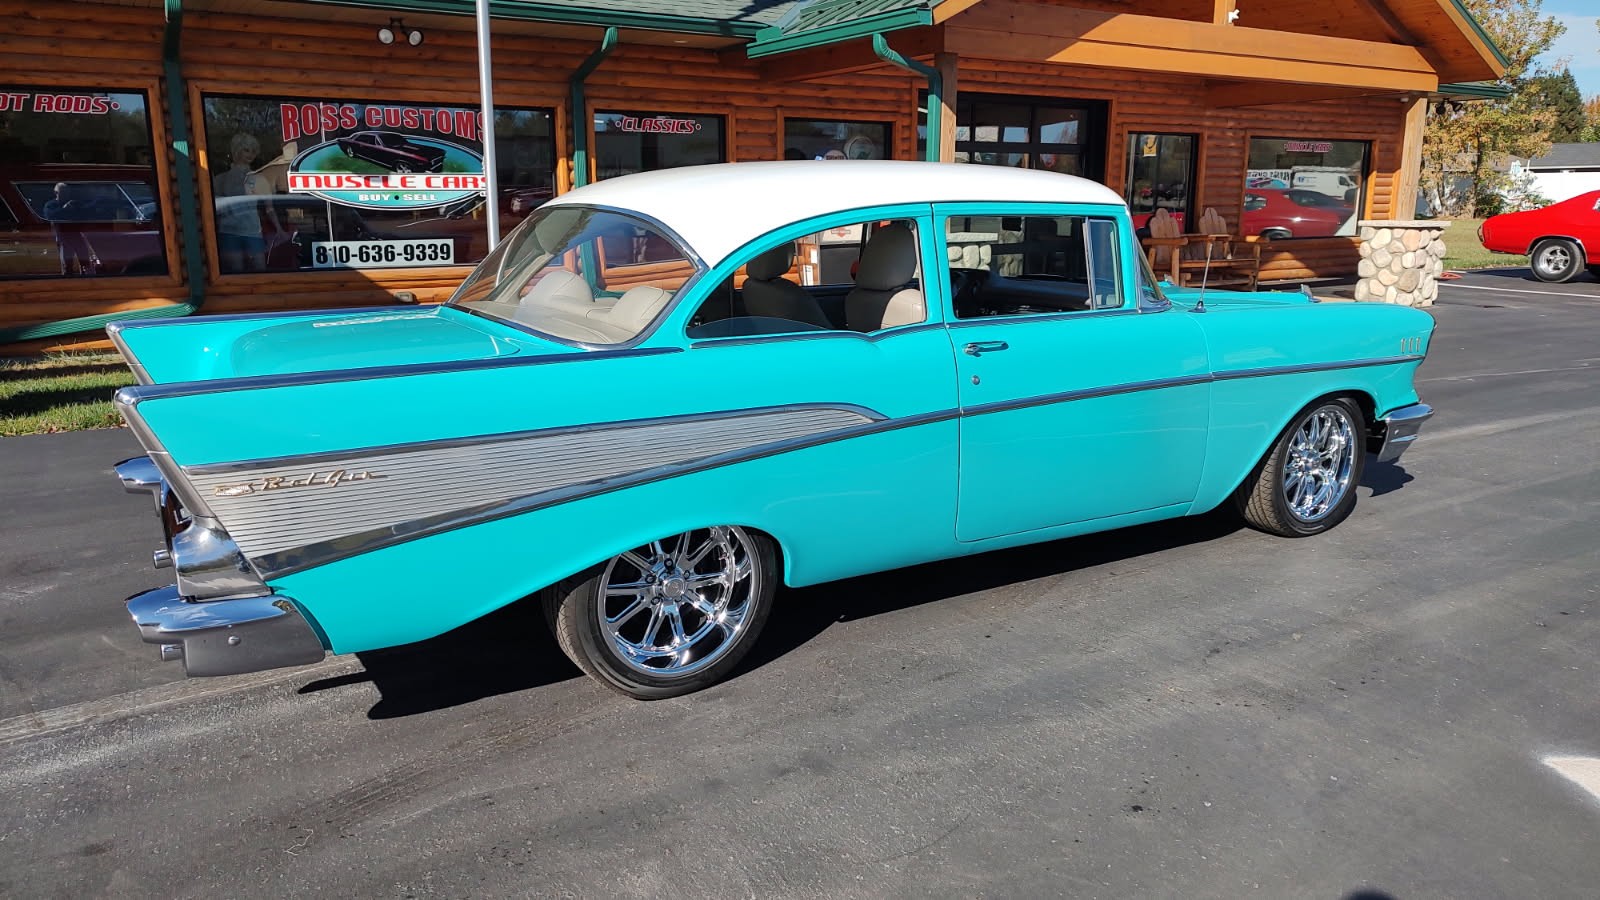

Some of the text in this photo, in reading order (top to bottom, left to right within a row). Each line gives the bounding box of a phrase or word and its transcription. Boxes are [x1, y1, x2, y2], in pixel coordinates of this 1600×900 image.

[33, 94, 110, 114] RODS
[280, 103, 357, 142] ROSS
[622, 117, 695, 133] CLASSICS
[289, 175, 417, 188] MUSCLE
[358, 193, 438, 201] BUY SELL
[315, 243, 451, 264] 810-636-9339
